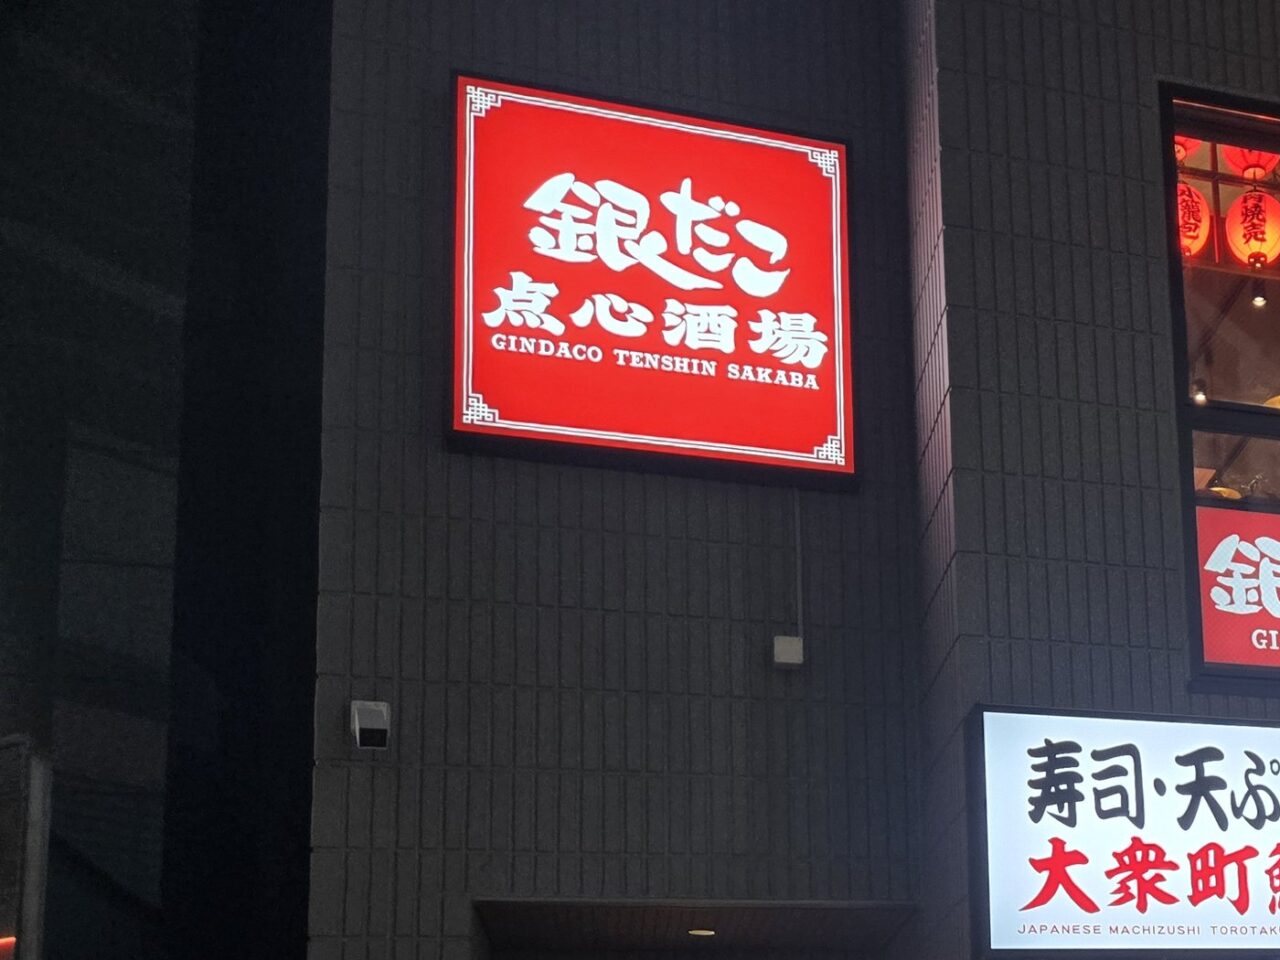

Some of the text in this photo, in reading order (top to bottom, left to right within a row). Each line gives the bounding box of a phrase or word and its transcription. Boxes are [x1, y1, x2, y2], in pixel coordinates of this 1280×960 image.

[523, 172, 790, 297] 銀だこ
[482, 271, 828, 369] 点心酒場
[490, 333, 819, 390] GINDACO TENSHIN SAKABA
[1017, 923, 1101, 935] JAPANESE
[1109, 924, 1201, 936] MACHIZUSHI
